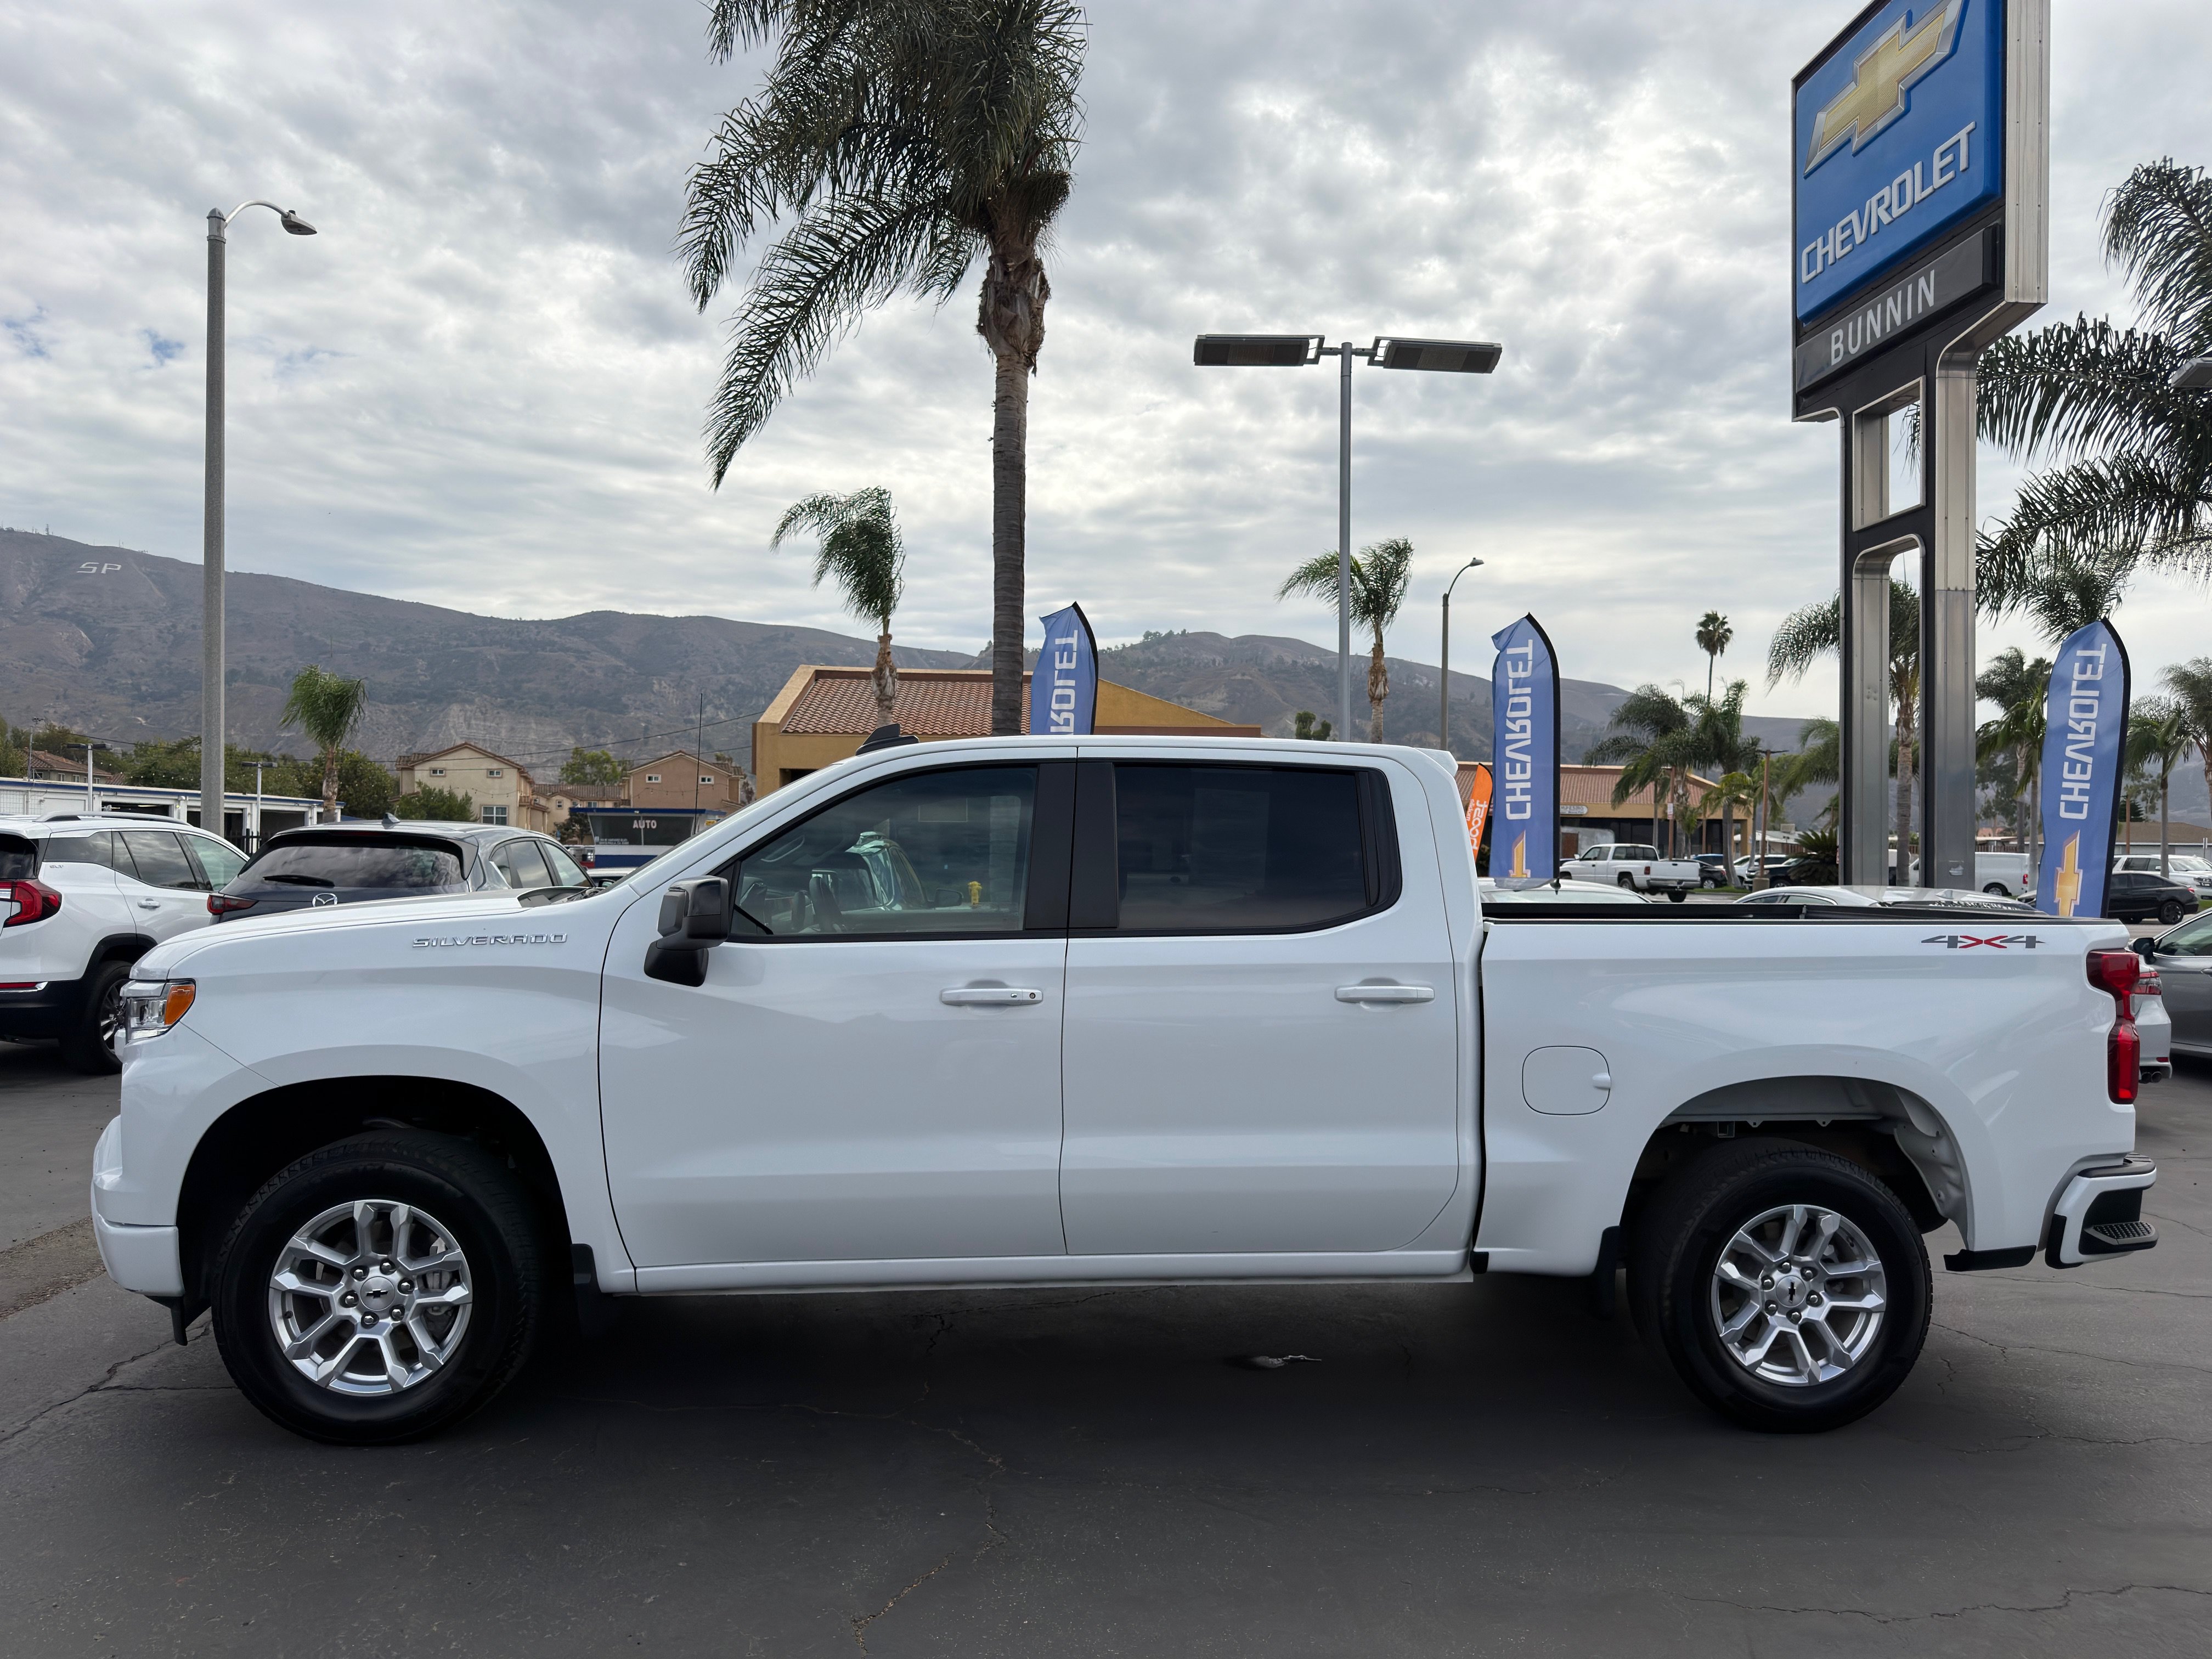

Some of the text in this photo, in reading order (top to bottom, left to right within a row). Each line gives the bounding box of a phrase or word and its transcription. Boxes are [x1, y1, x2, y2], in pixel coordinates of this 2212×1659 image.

[1802, 121, 1977, 284] CHEVROLET
[1831, 269, 1935, 366] BUNNIN
[76, 562, 122, 574] SP
[633, 820, 657, 829] AUTO
[413, 933, 568, 947] SILVERADO
